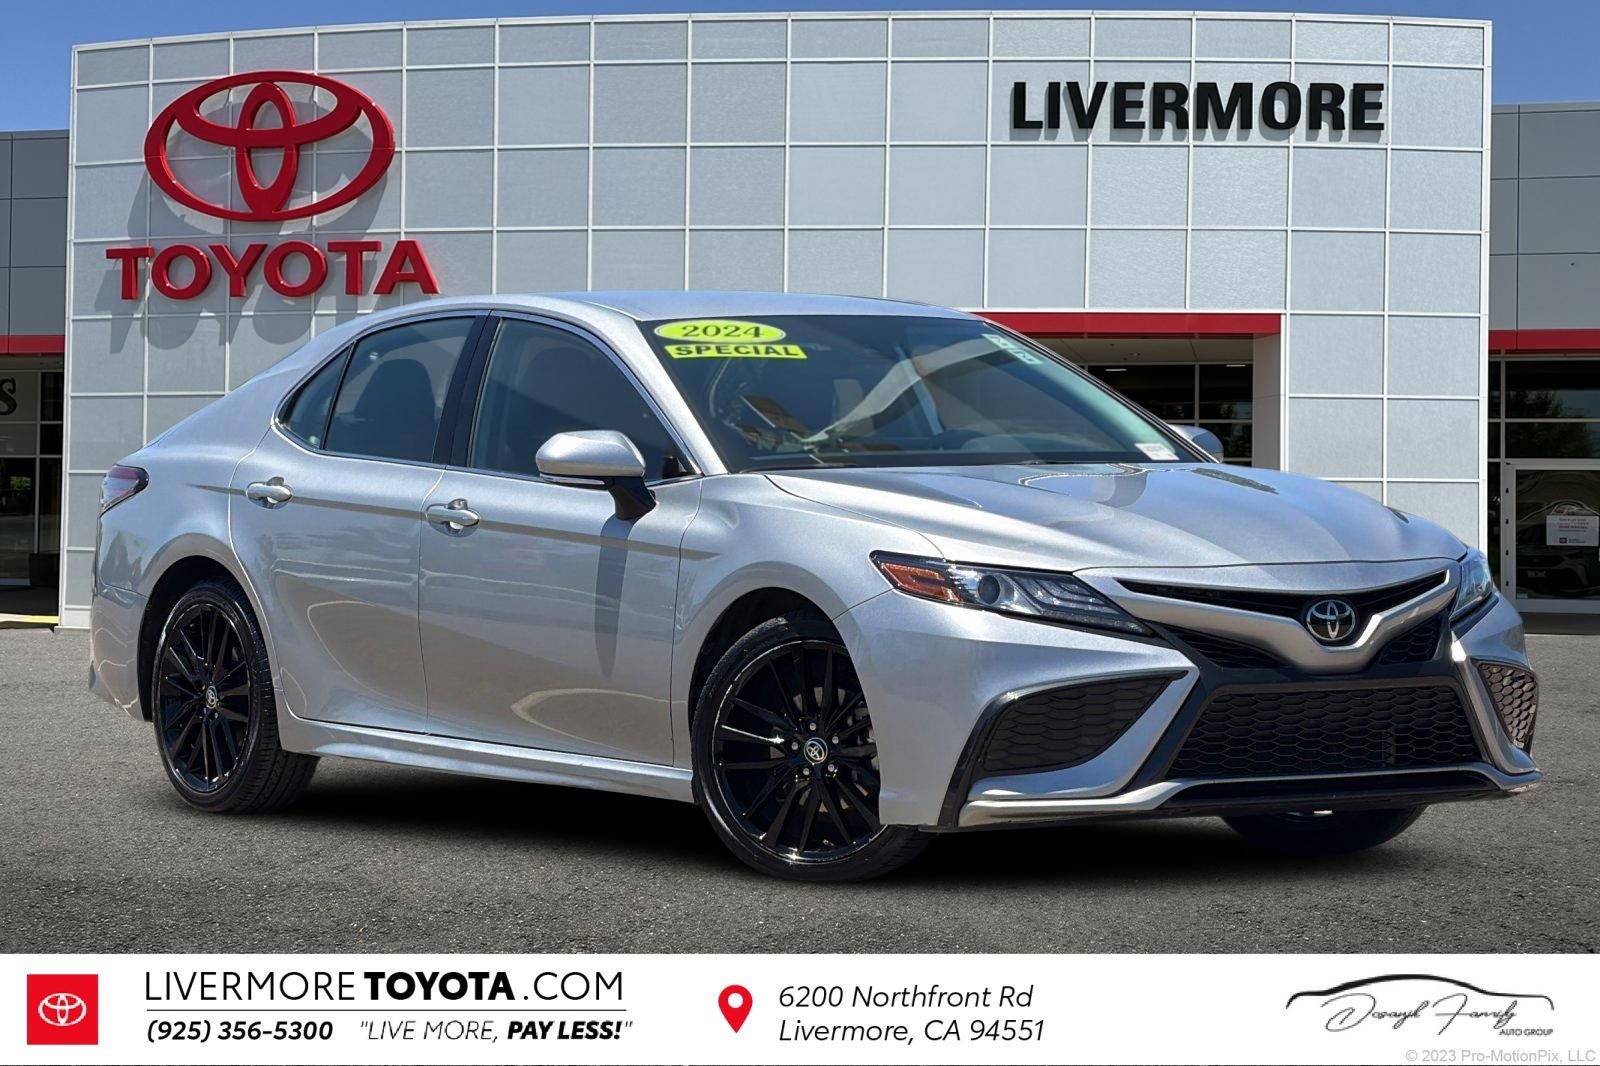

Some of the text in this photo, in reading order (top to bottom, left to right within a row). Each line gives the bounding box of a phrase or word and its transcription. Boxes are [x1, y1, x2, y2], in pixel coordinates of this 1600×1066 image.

[1012, 81, 1385, 131] LIVERMORE
[105, 240, 440, 300] TOYOTA
[681, 324, 763, 338] 2024
[674, 344, 800, 356] SPECIAL
